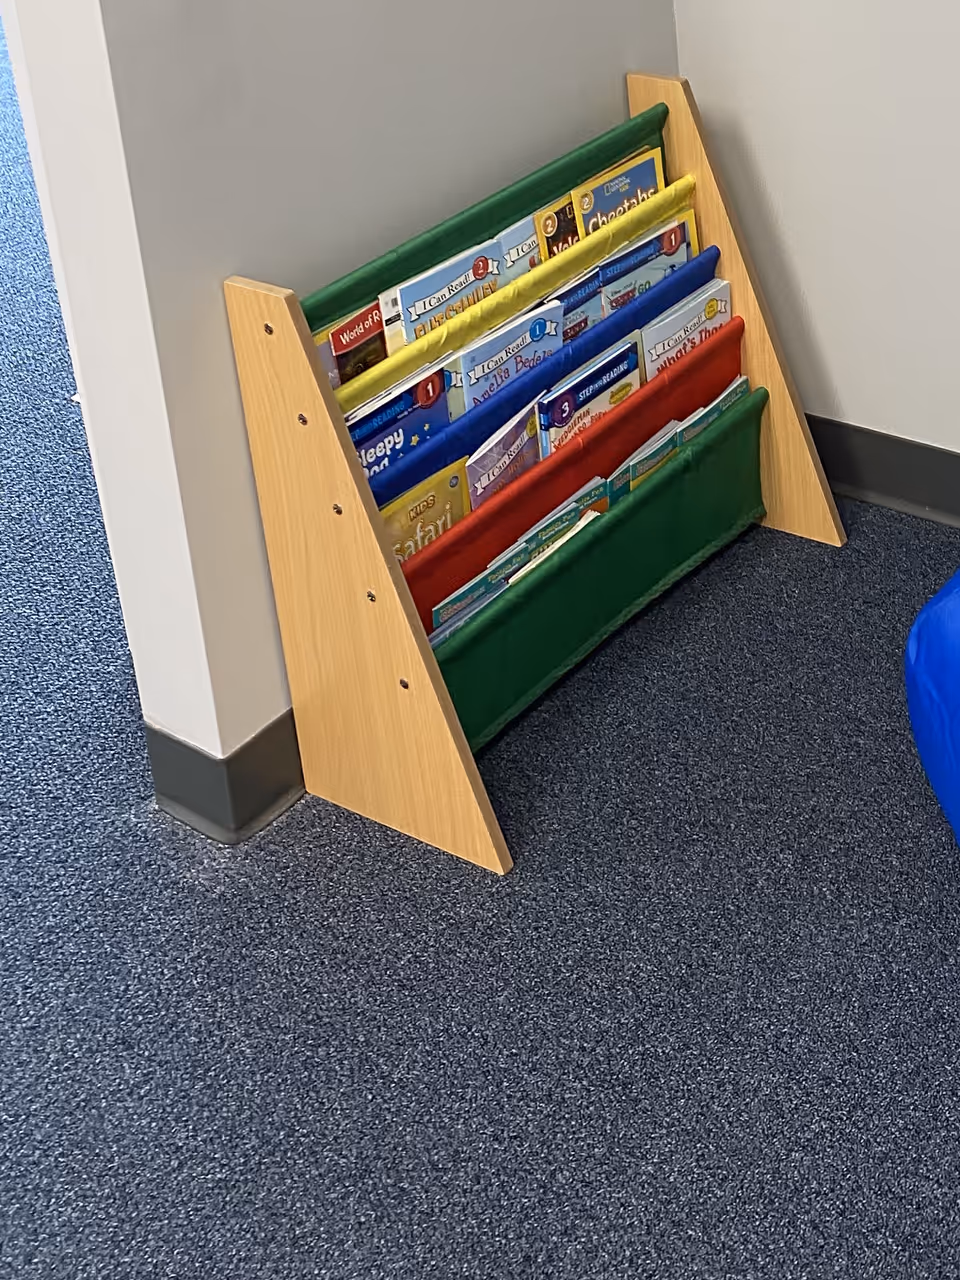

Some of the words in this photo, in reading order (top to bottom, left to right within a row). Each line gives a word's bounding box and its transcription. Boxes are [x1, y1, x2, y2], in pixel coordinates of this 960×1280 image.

[584, 197, 591, 209] 2
[546, 220, 553, 232] 2
[521, 240, 537, 254] Can
[423, 301, 427, 310] I
[428, 293, 447, 307] Can
[447, 273, 471, 295] Read!
[340, 322, 364, 345] World
[364, 314, 373, 328] of
[667, 335, 683, 348] Can
[486, 356, 504, 370] Can
[504, 335, 527, 358] Read!
[427, 382, 433, 397] 1
[578, 385, 594, 401] STEP
[602, 361, 628, 385] READING
[562, 401, 569, 418] 3
[408, 494, 436, 521] KIDS
